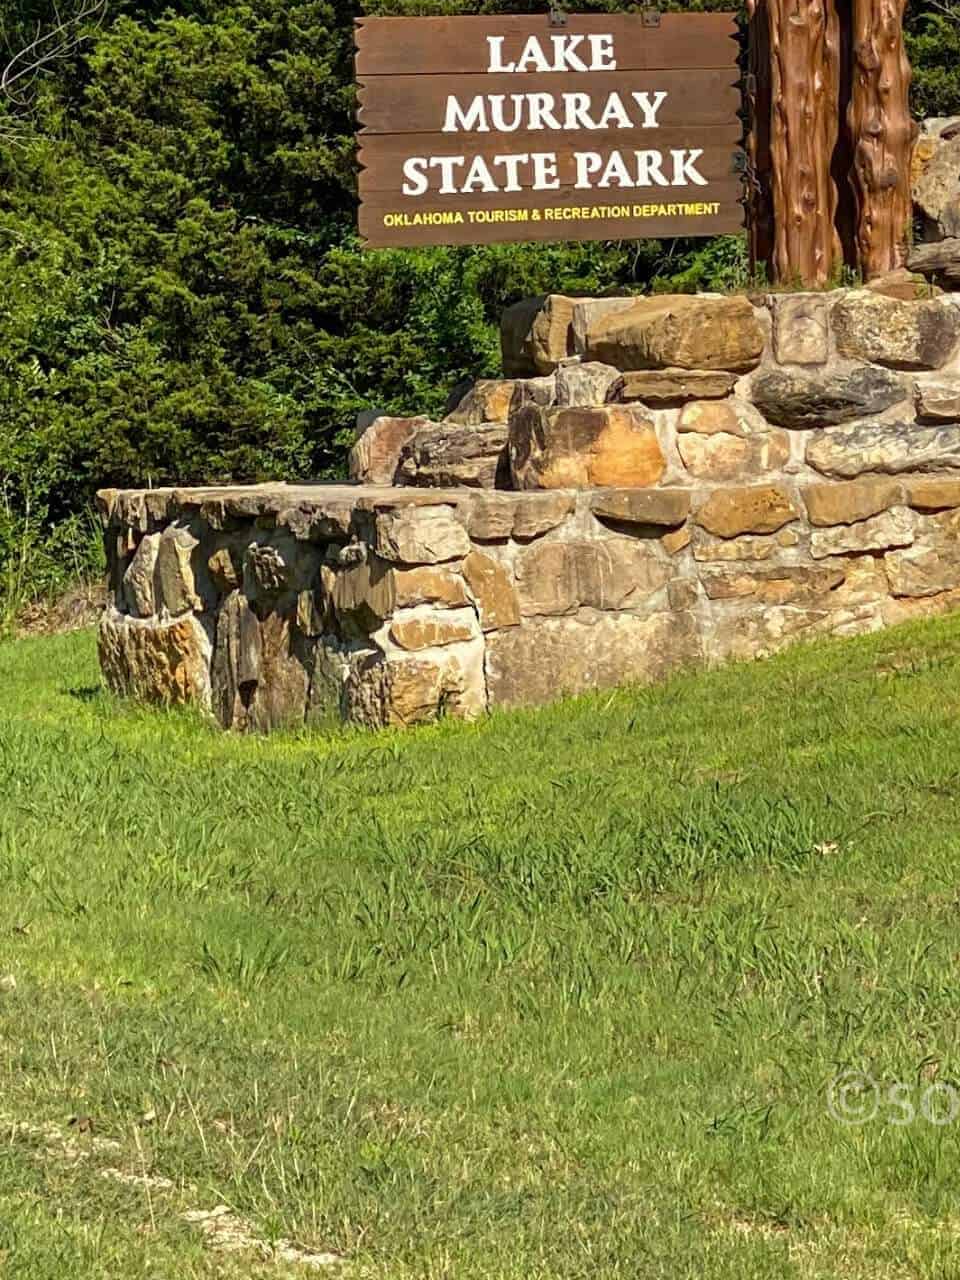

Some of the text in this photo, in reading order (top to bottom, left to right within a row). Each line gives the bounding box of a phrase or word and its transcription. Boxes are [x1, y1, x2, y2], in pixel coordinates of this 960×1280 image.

[487, 34, 617, 73] LAKE
[442, 91, 667, 133] MURRAY
[402, 148, 708, 196] STATE PARK
[383, 203, 720, 226] OKLAHOMA TOURISM & RECREATION DEPARTMENT
